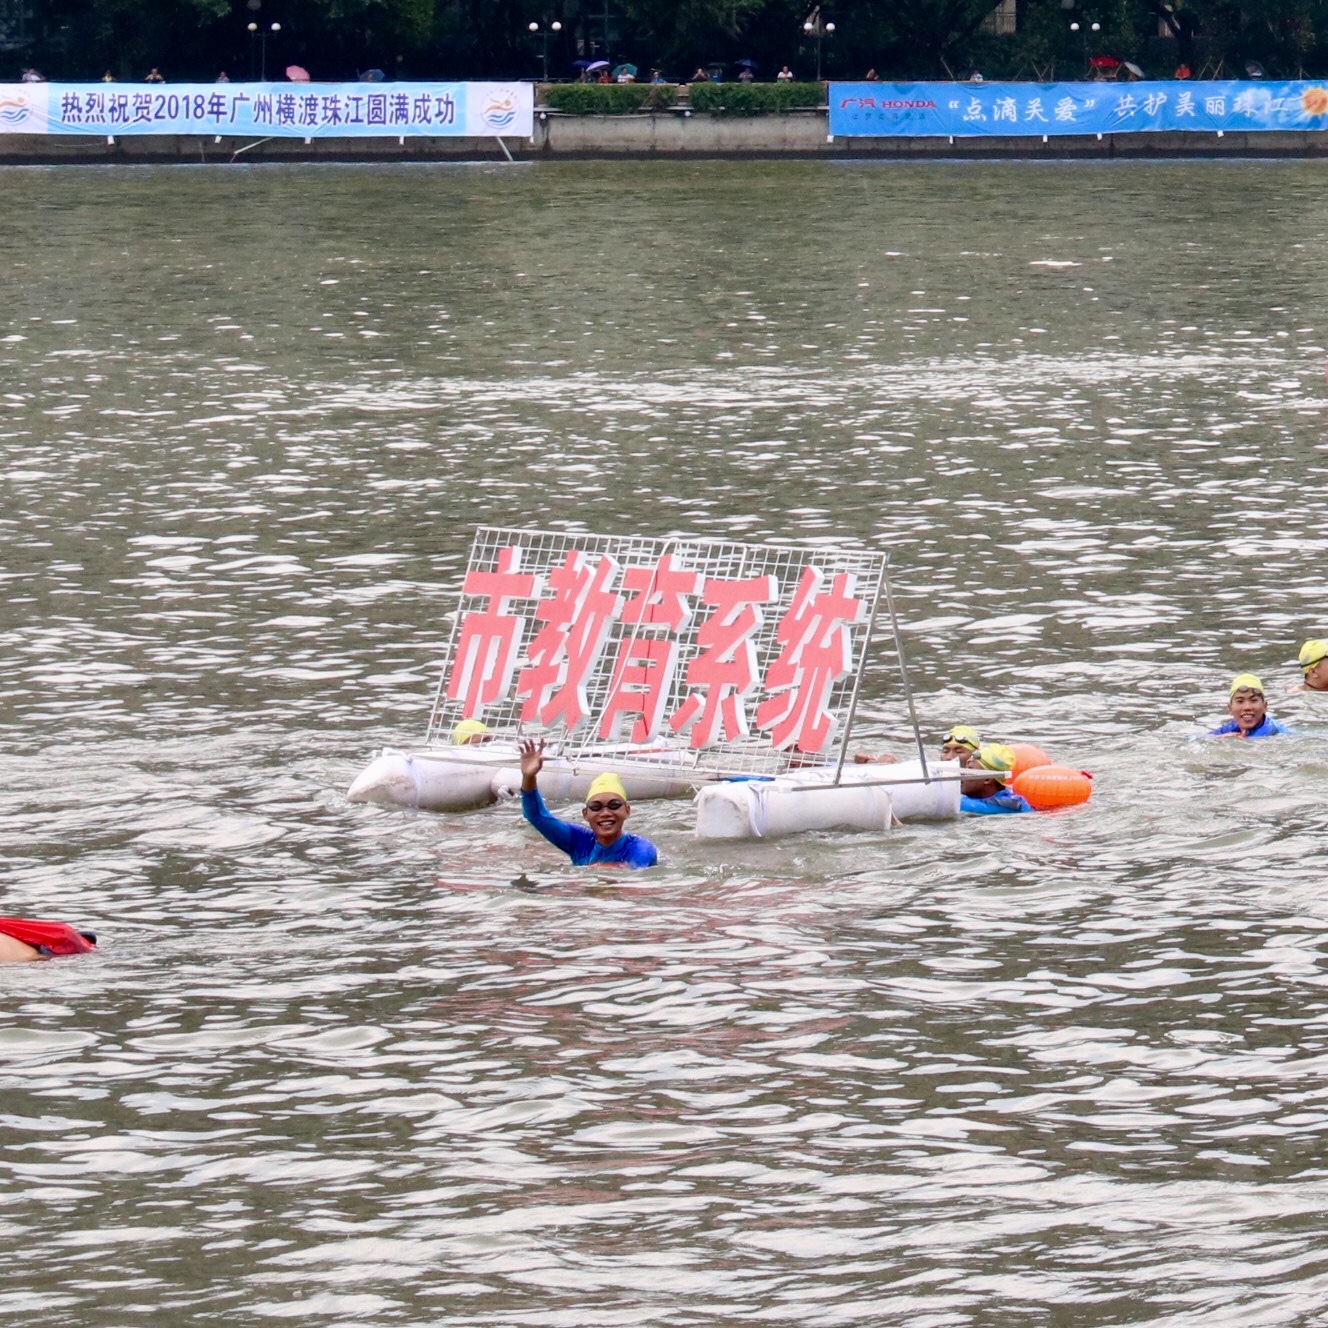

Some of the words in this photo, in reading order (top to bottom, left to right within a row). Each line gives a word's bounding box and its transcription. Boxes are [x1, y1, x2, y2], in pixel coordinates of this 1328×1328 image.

[61, 92, 456, 127] 热烈祝贺2018年广州横渡珠江圆满成功
[882, 99, 938, 109] HONDA
[1114, 91, 1288, 117] 共护美丽珠江
[446, 545, 868, 755] 市教育系统
